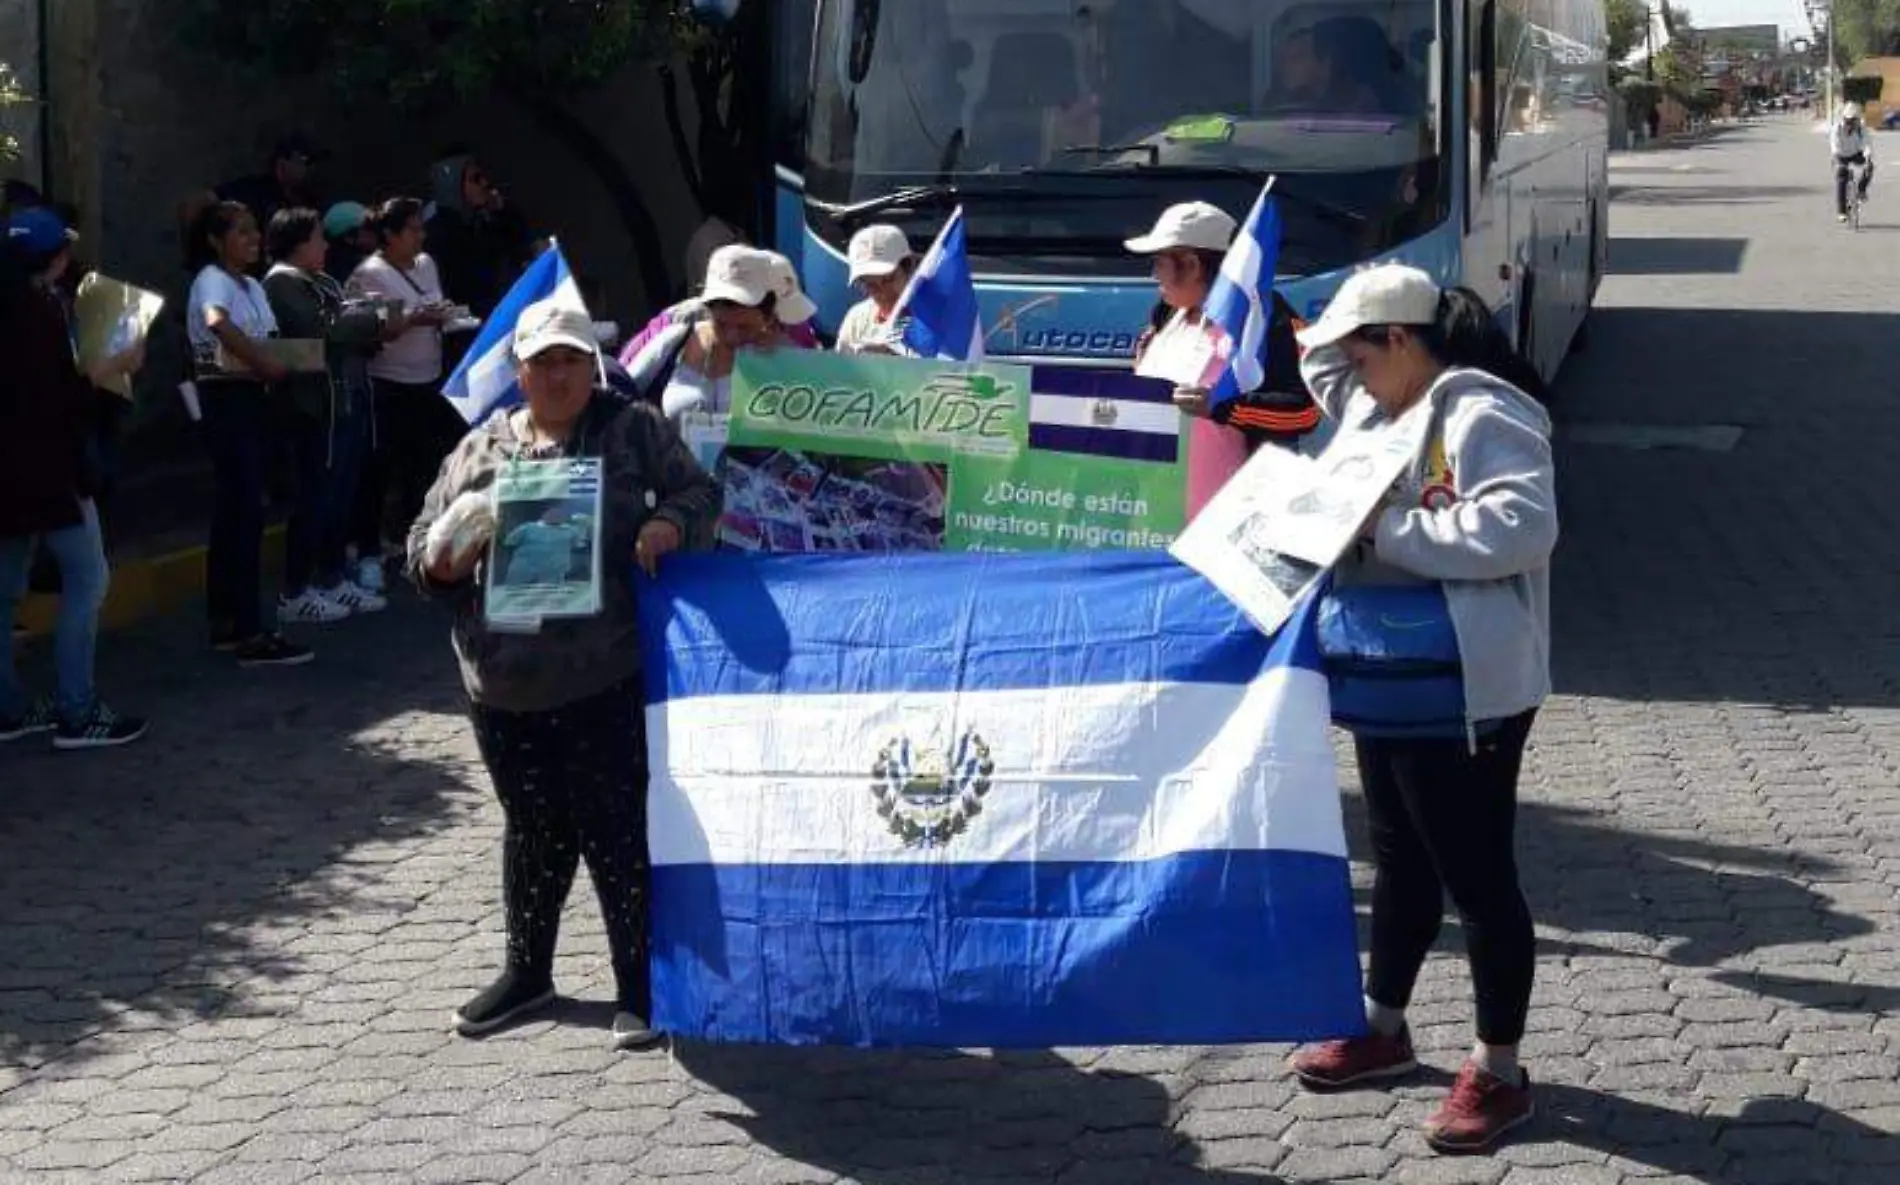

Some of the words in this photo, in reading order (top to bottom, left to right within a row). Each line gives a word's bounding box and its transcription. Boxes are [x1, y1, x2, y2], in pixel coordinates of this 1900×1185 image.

[982, 481, 1076, 510] ¿Dónde
[1084, 490, 1148, 516] están
[954, 510, 1051, 537] nuestros
